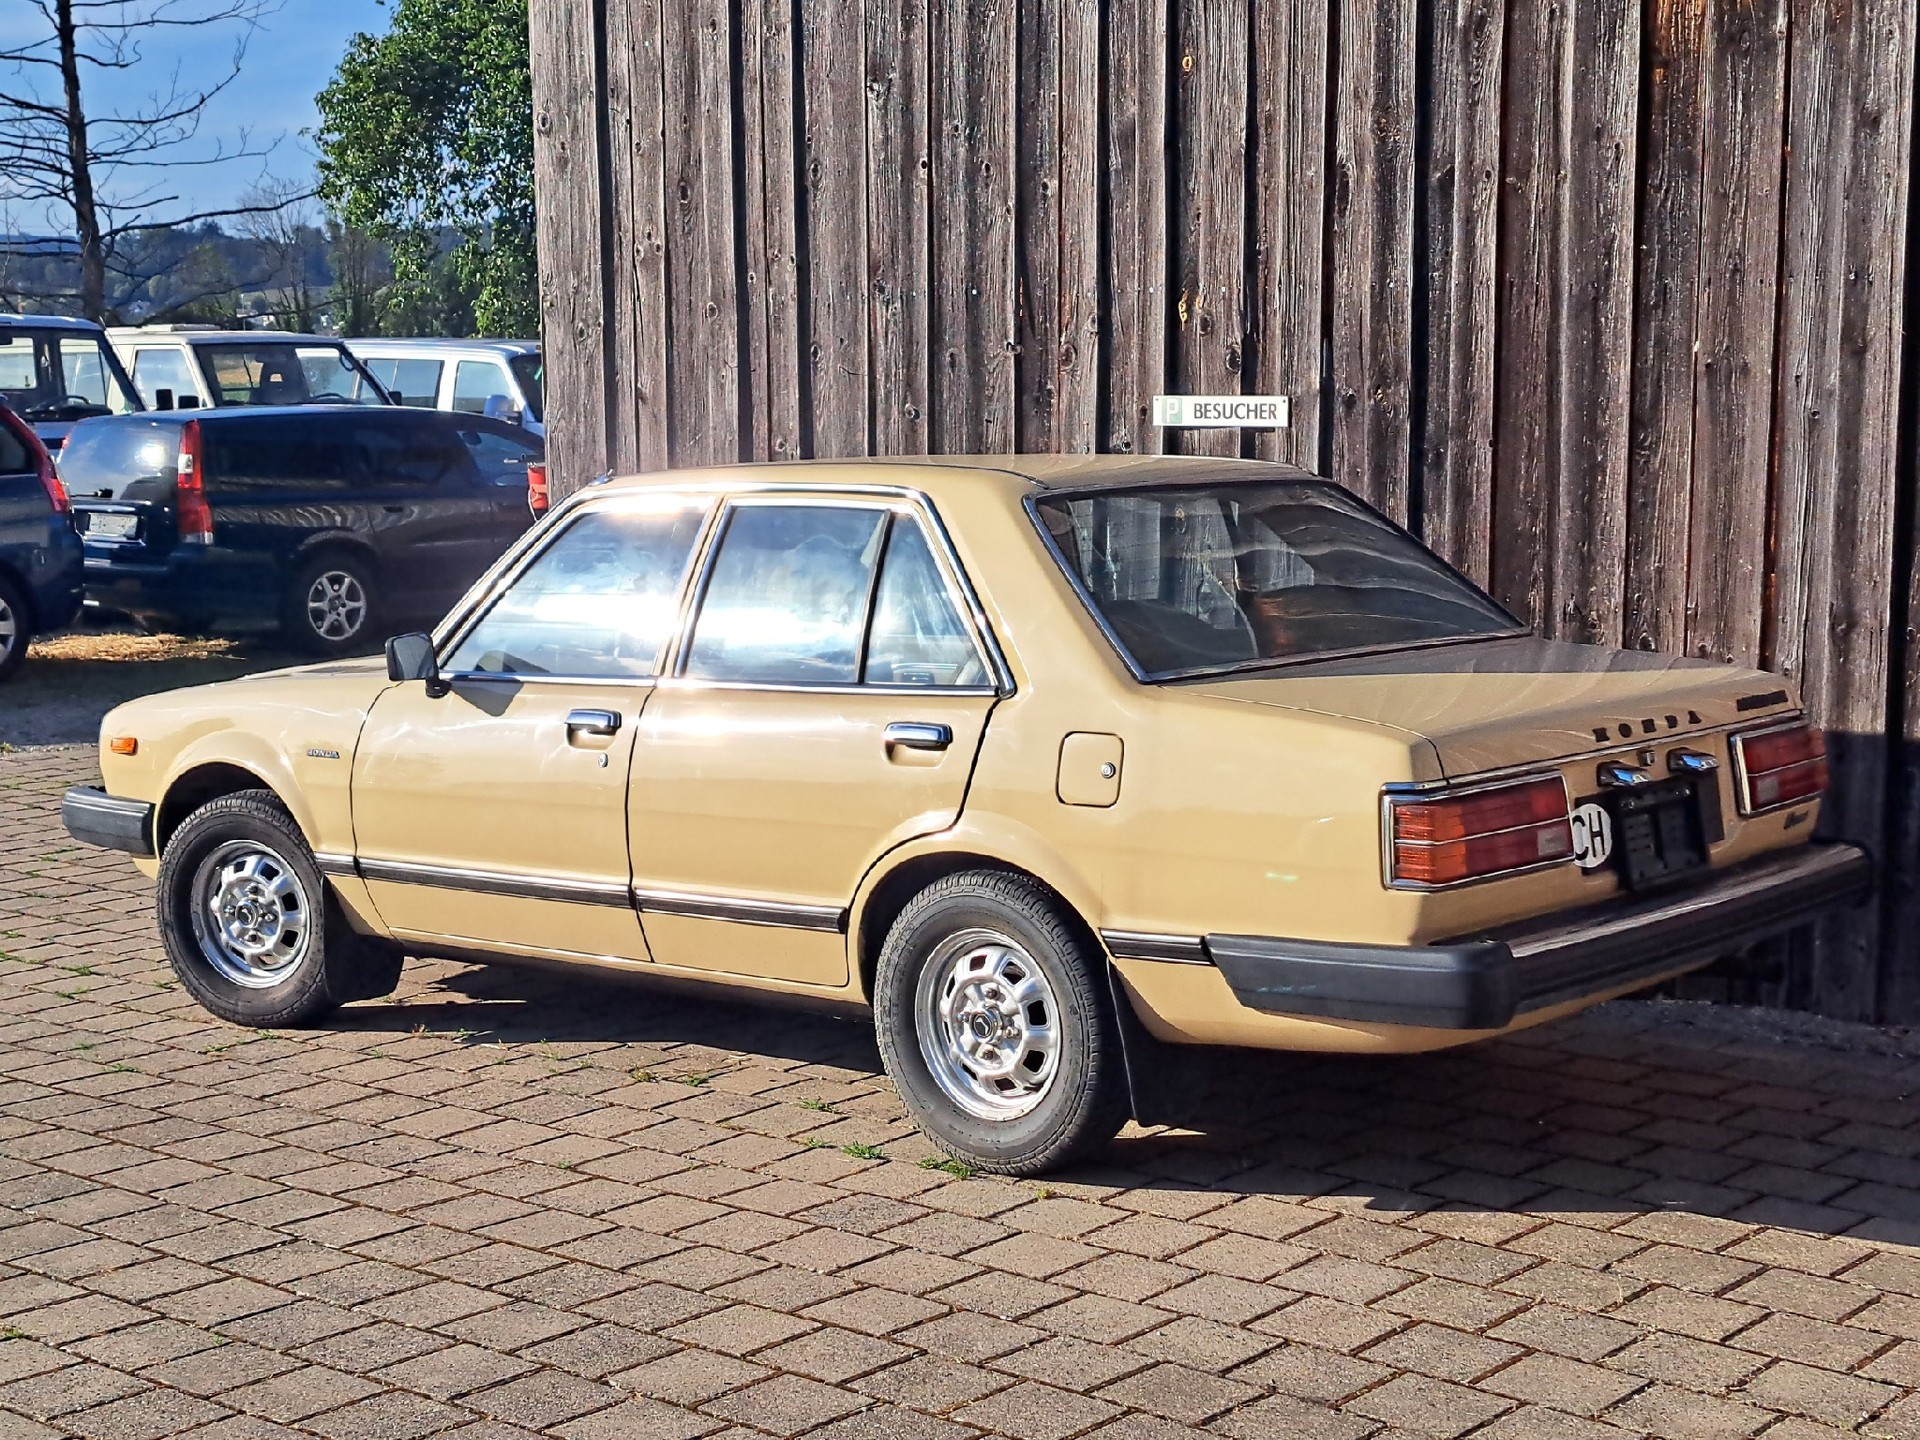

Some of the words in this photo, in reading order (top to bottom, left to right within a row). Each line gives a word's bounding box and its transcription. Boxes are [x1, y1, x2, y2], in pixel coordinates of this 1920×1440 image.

[1165, 398, 1179, 423] P
[1194, 403, 1277, 420] BESUCHER
[1572, 810, 1606, 861] CH
